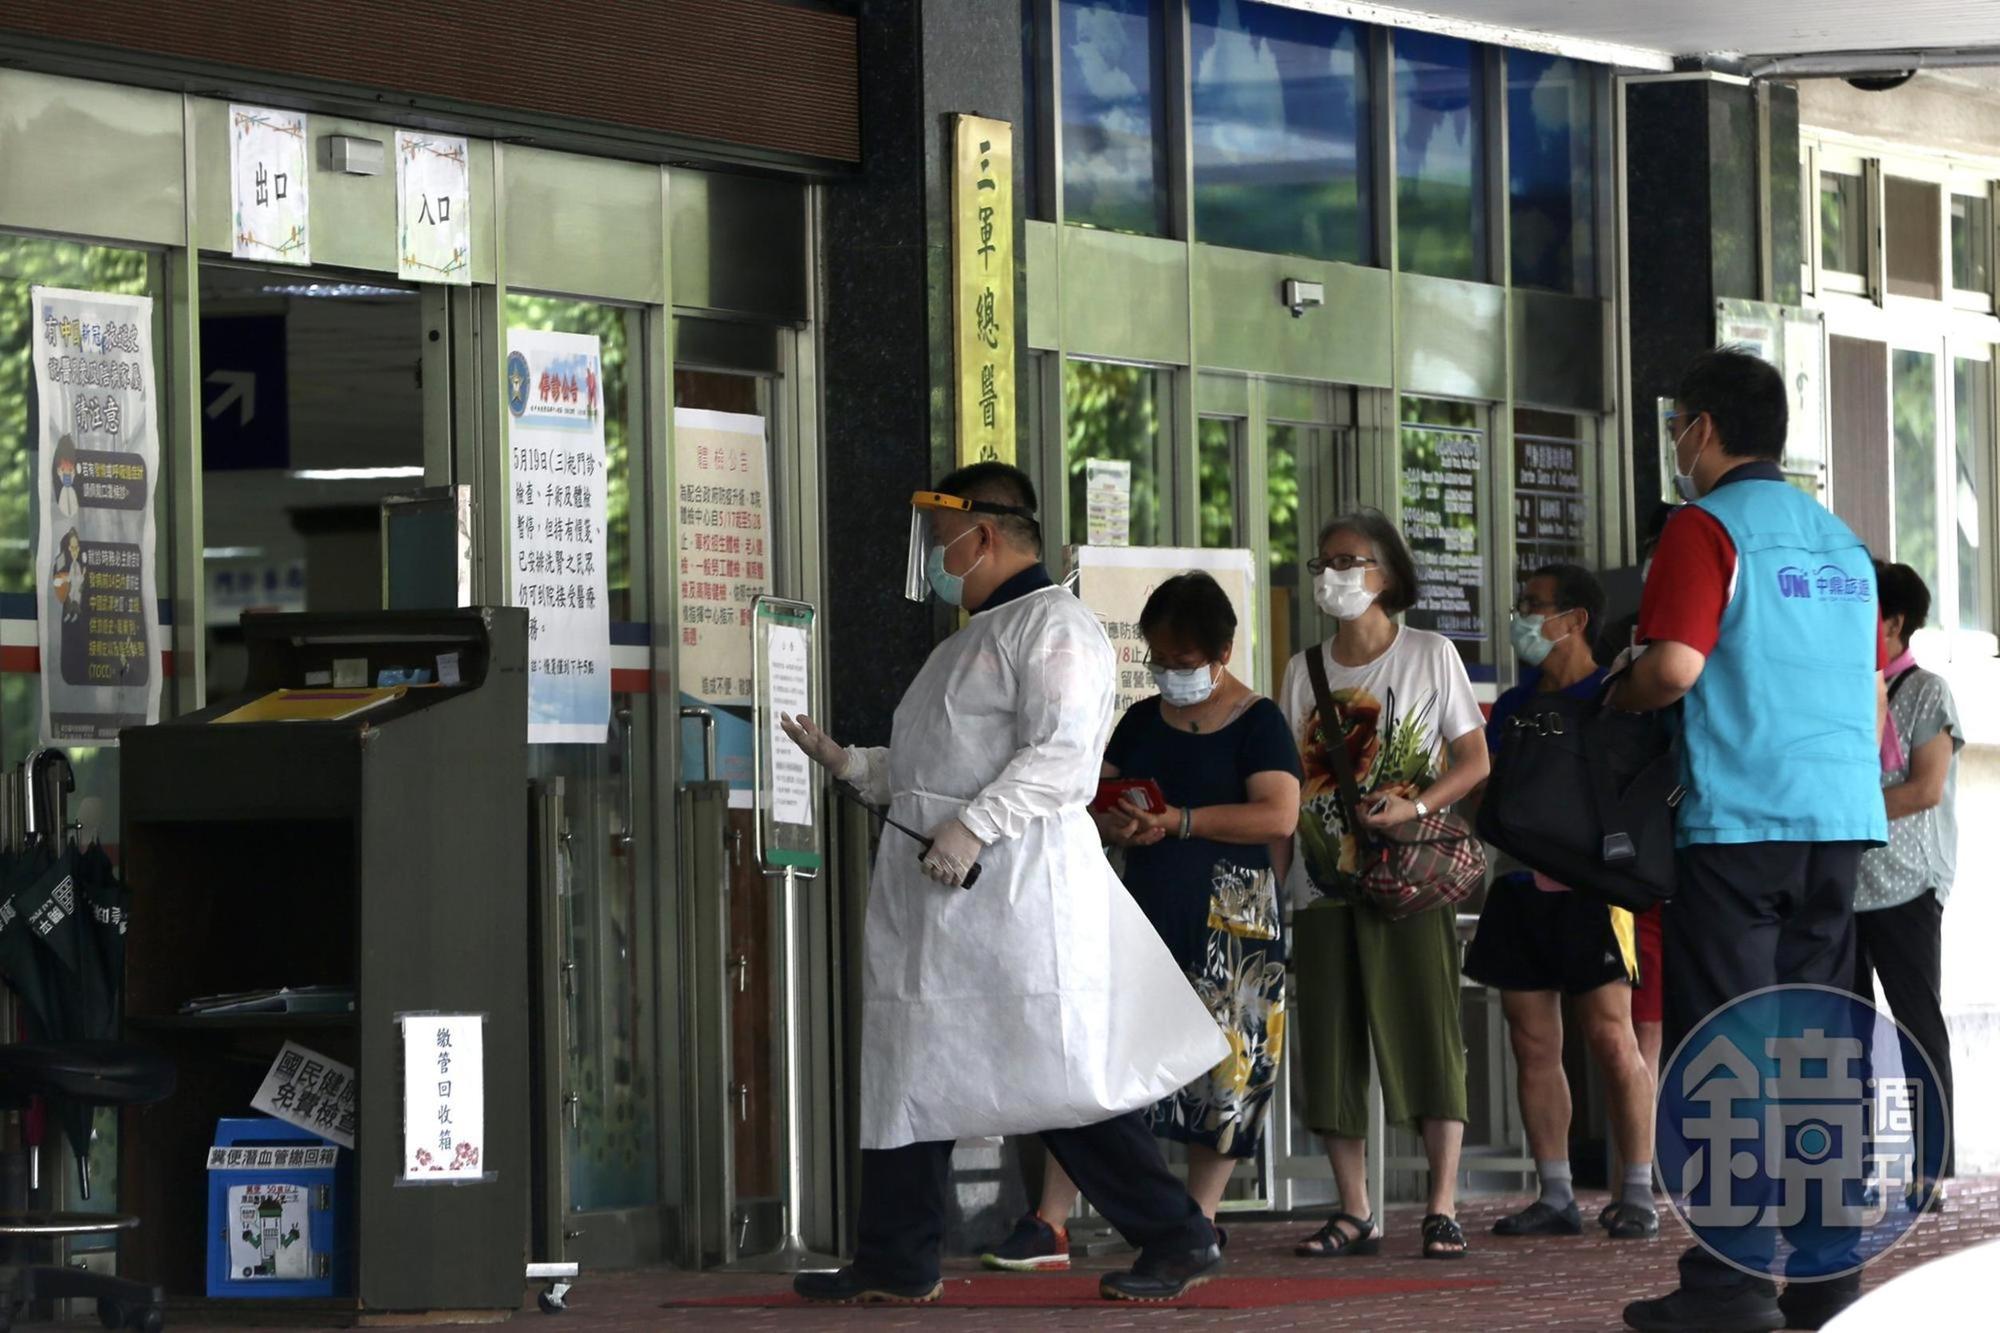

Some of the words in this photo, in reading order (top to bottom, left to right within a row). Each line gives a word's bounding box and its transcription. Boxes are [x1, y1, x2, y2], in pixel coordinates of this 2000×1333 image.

[255, 161, 287, 208] 出口
[417, 193, 450, 226] 入口
[538, 368, 579, 404] 停診公告
[75, 393, 120, 435] 請注意
[697, 444, 749, 473] 體檢公告
[436, 1027, 452, 1151] 繳管回收箱
